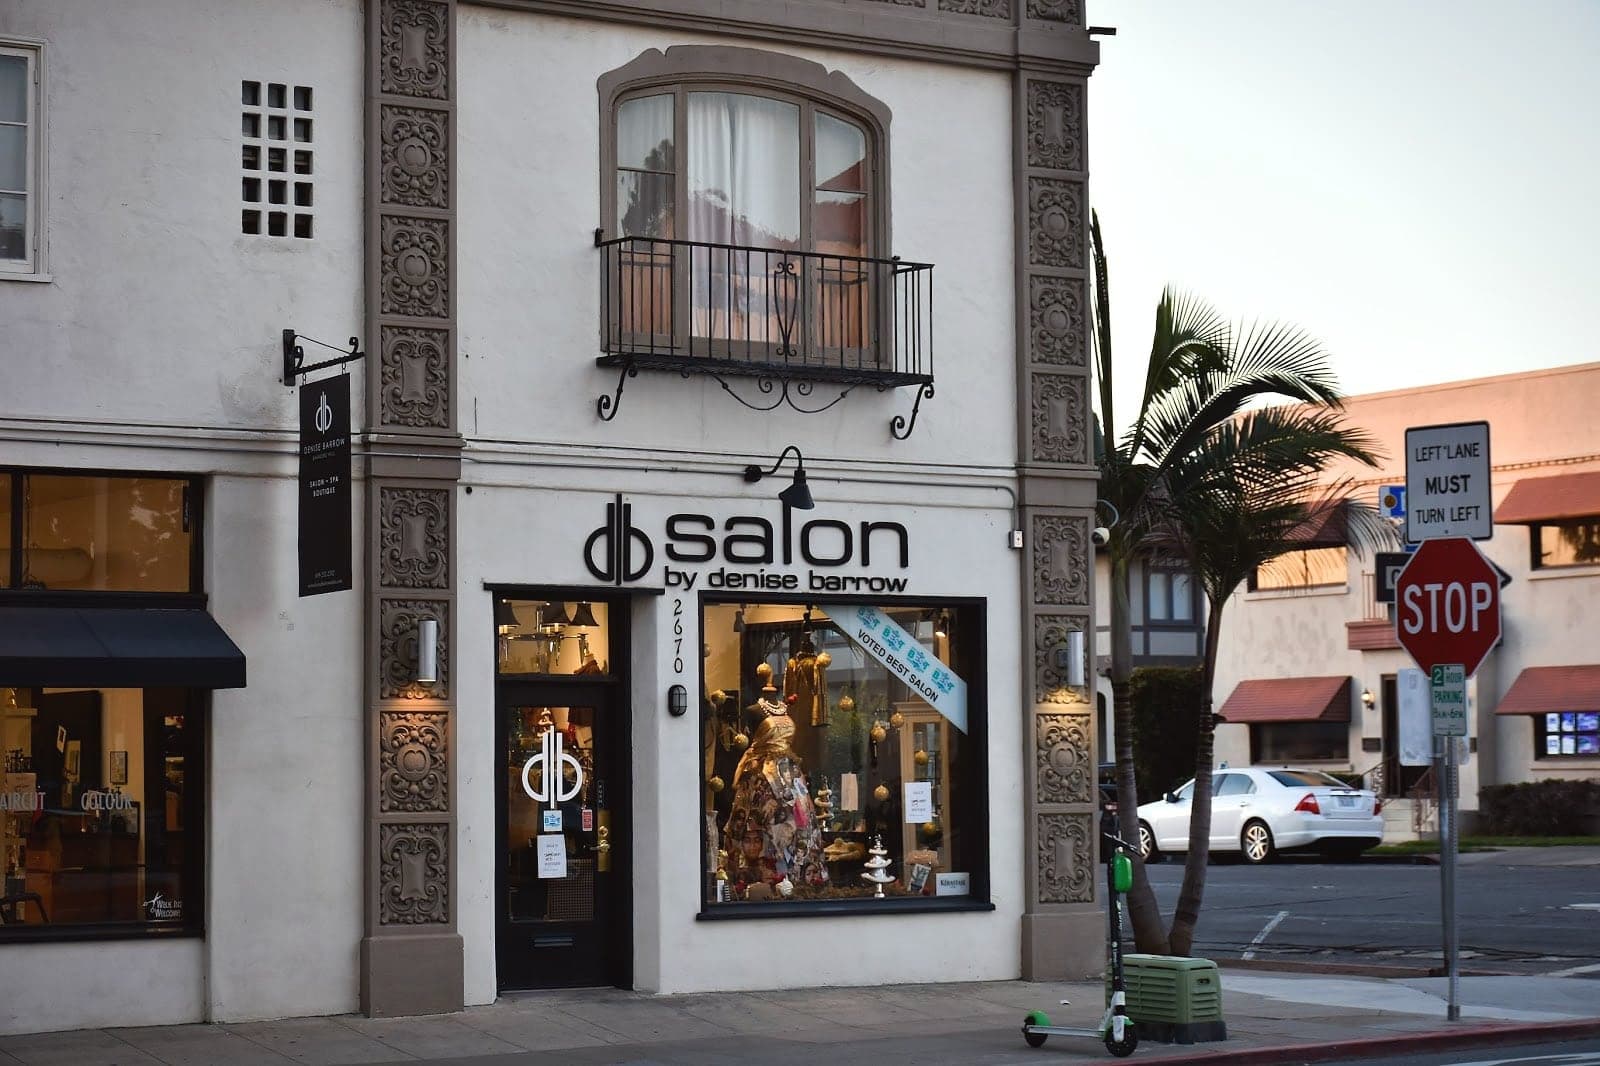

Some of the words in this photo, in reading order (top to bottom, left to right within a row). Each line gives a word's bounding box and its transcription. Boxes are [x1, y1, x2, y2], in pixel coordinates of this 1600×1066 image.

[304, 443, 321, 455] DENISE
[322, 438, 345, 450] BARROW
[1415, 445, 1442, 462] LEFT
[1447, 442, 1480, 459] LANE
[309, 478, 325, 488] SALON
[329, 475, 339, 484] SPA
[1425, 473, 1471, 495] MUST
[313, 486, 336, 497] BOUTIQUE
[1415, 507, 1445, 524] TURN
[1450, 505, 1481, 522] LEFT
[665, 503, 909, 568] salon
[664, 566, 698, 591] by
[708, 567, 798, 590] denise
[809, 570, 908, 593] barrow
[1403, 581, 1492, 634] STOP
[673, 598, 683, 674] 2670
[858, 629, 886, 657] VOTED
[886, 655, 910, 677] BEST
[909, 674, 939, 702] SALON
[1433, 667, 1442, 684] 2
[1445, 672, 1462, 683] HOUR
[1434, 690, 1463, 704] PARKING
[81, 792, 134, 810] COLOUR
